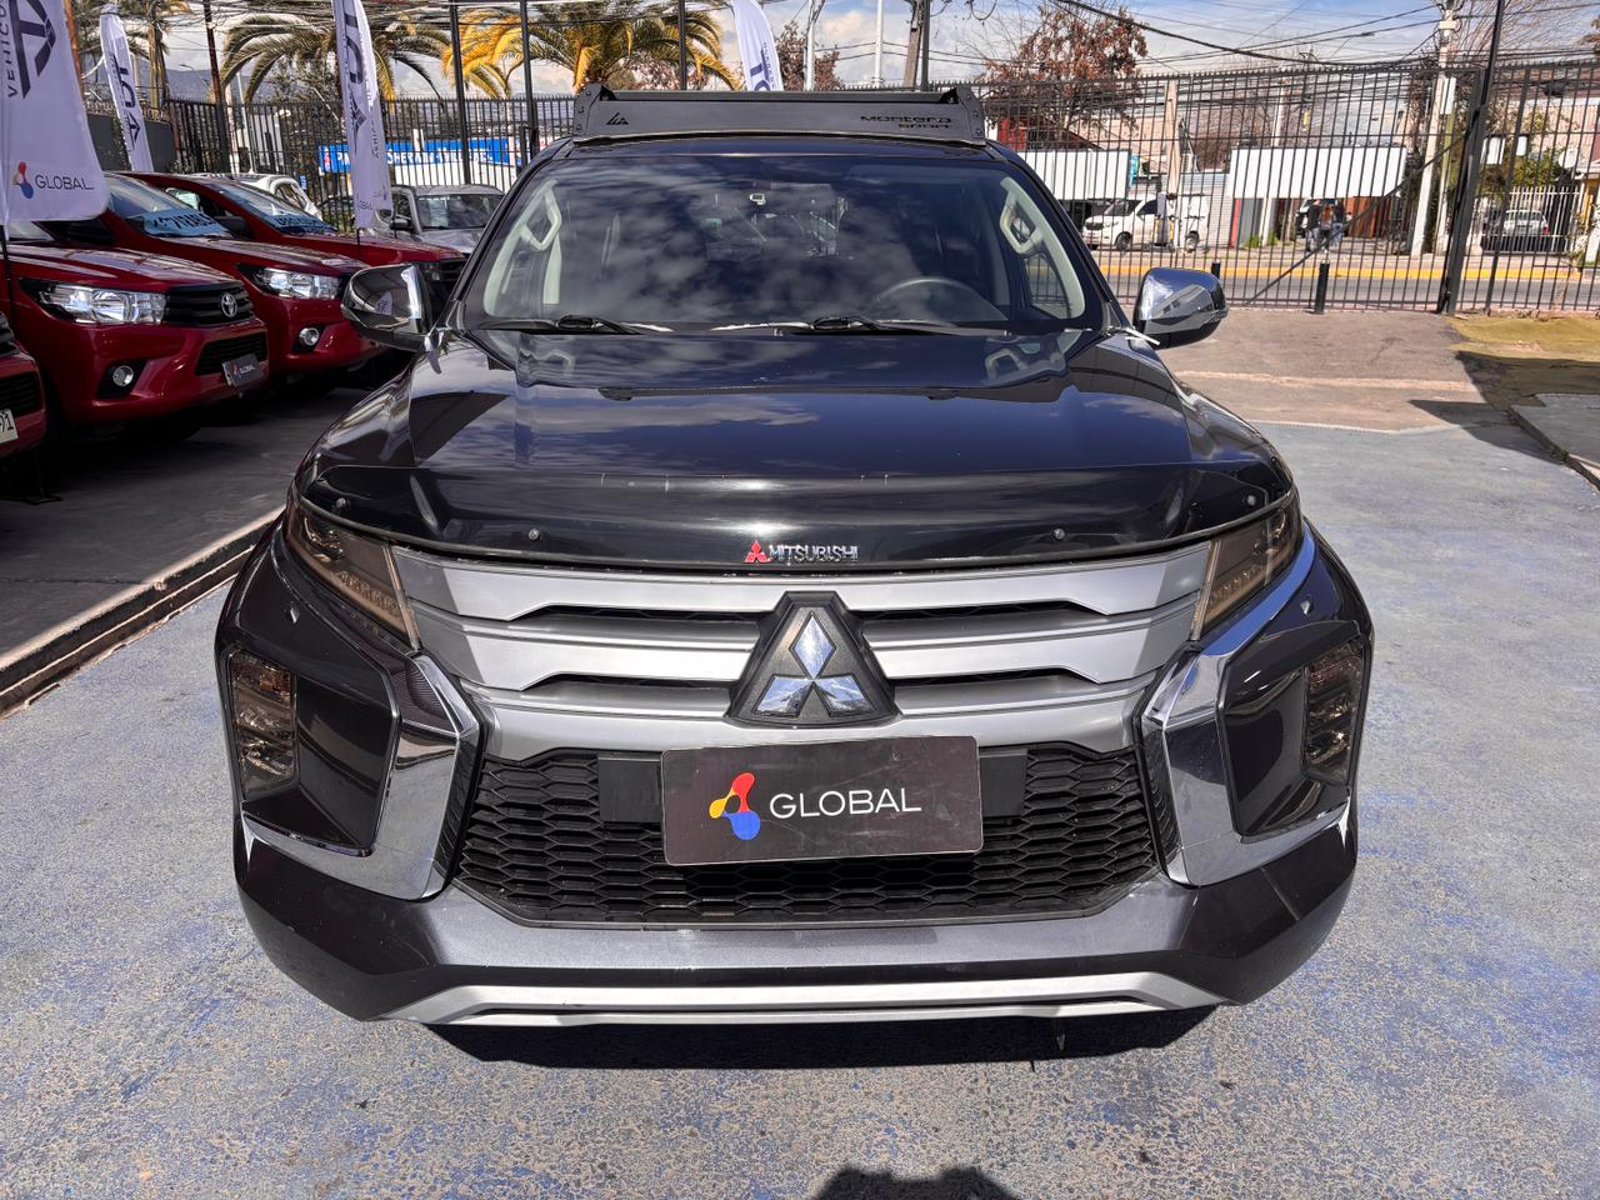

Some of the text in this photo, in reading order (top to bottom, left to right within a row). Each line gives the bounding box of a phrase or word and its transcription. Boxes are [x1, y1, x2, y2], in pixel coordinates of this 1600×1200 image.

[34, 174, 95, 191] GLOBAL
[768, 544, 859, 562] MITSUBISHI
[769, 787, 923, 820] GLOBAL
